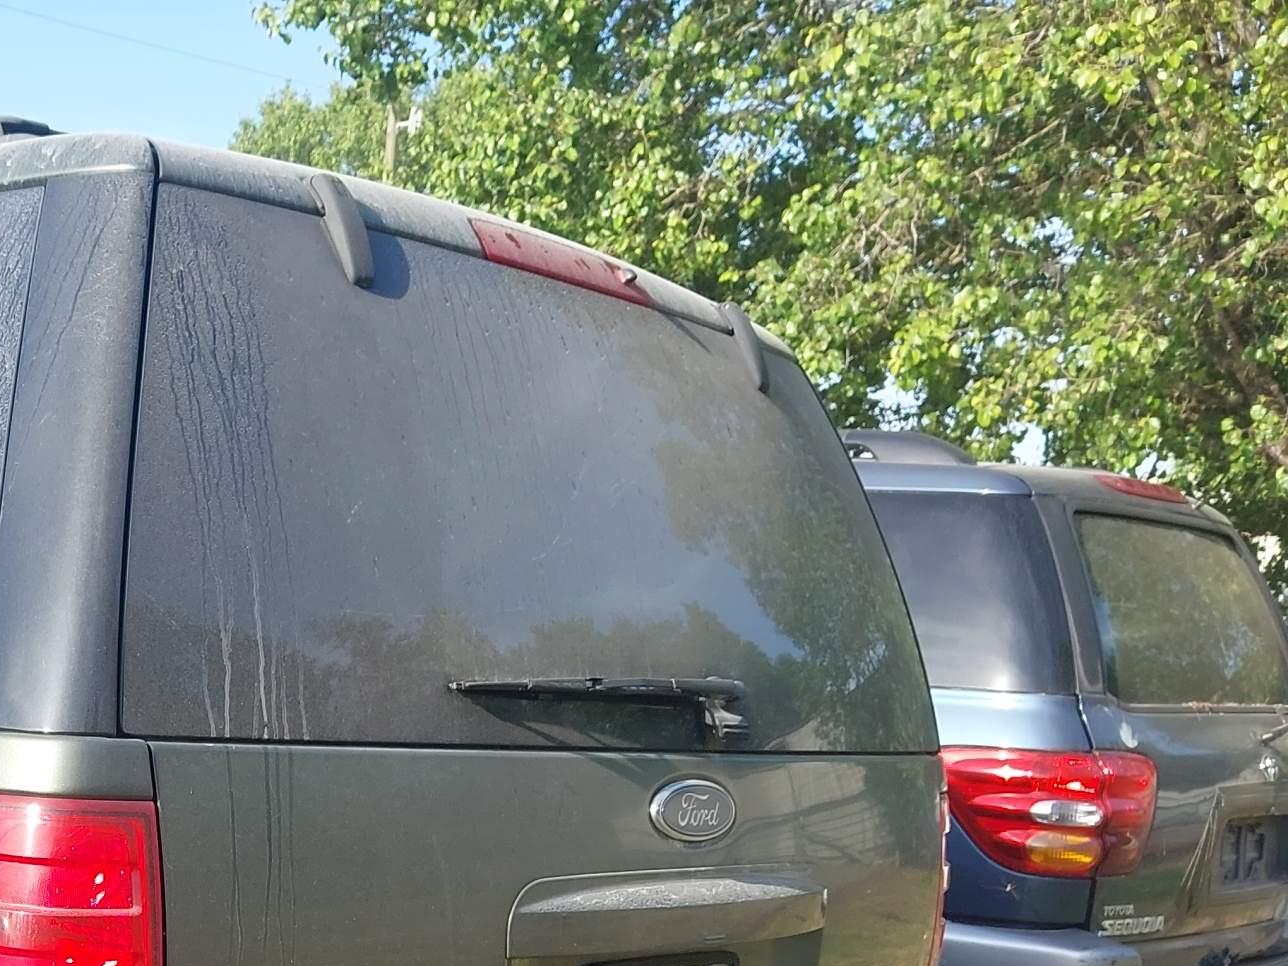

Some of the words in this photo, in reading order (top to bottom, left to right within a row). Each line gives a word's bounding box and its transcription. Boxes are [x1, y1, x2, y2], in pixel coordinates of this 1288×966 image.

[678, 792, 720, 827] Ford
[1103, 904, 1135, 917] TOYOTA
[1099, 915, 1165, 937] SEQUOIA
